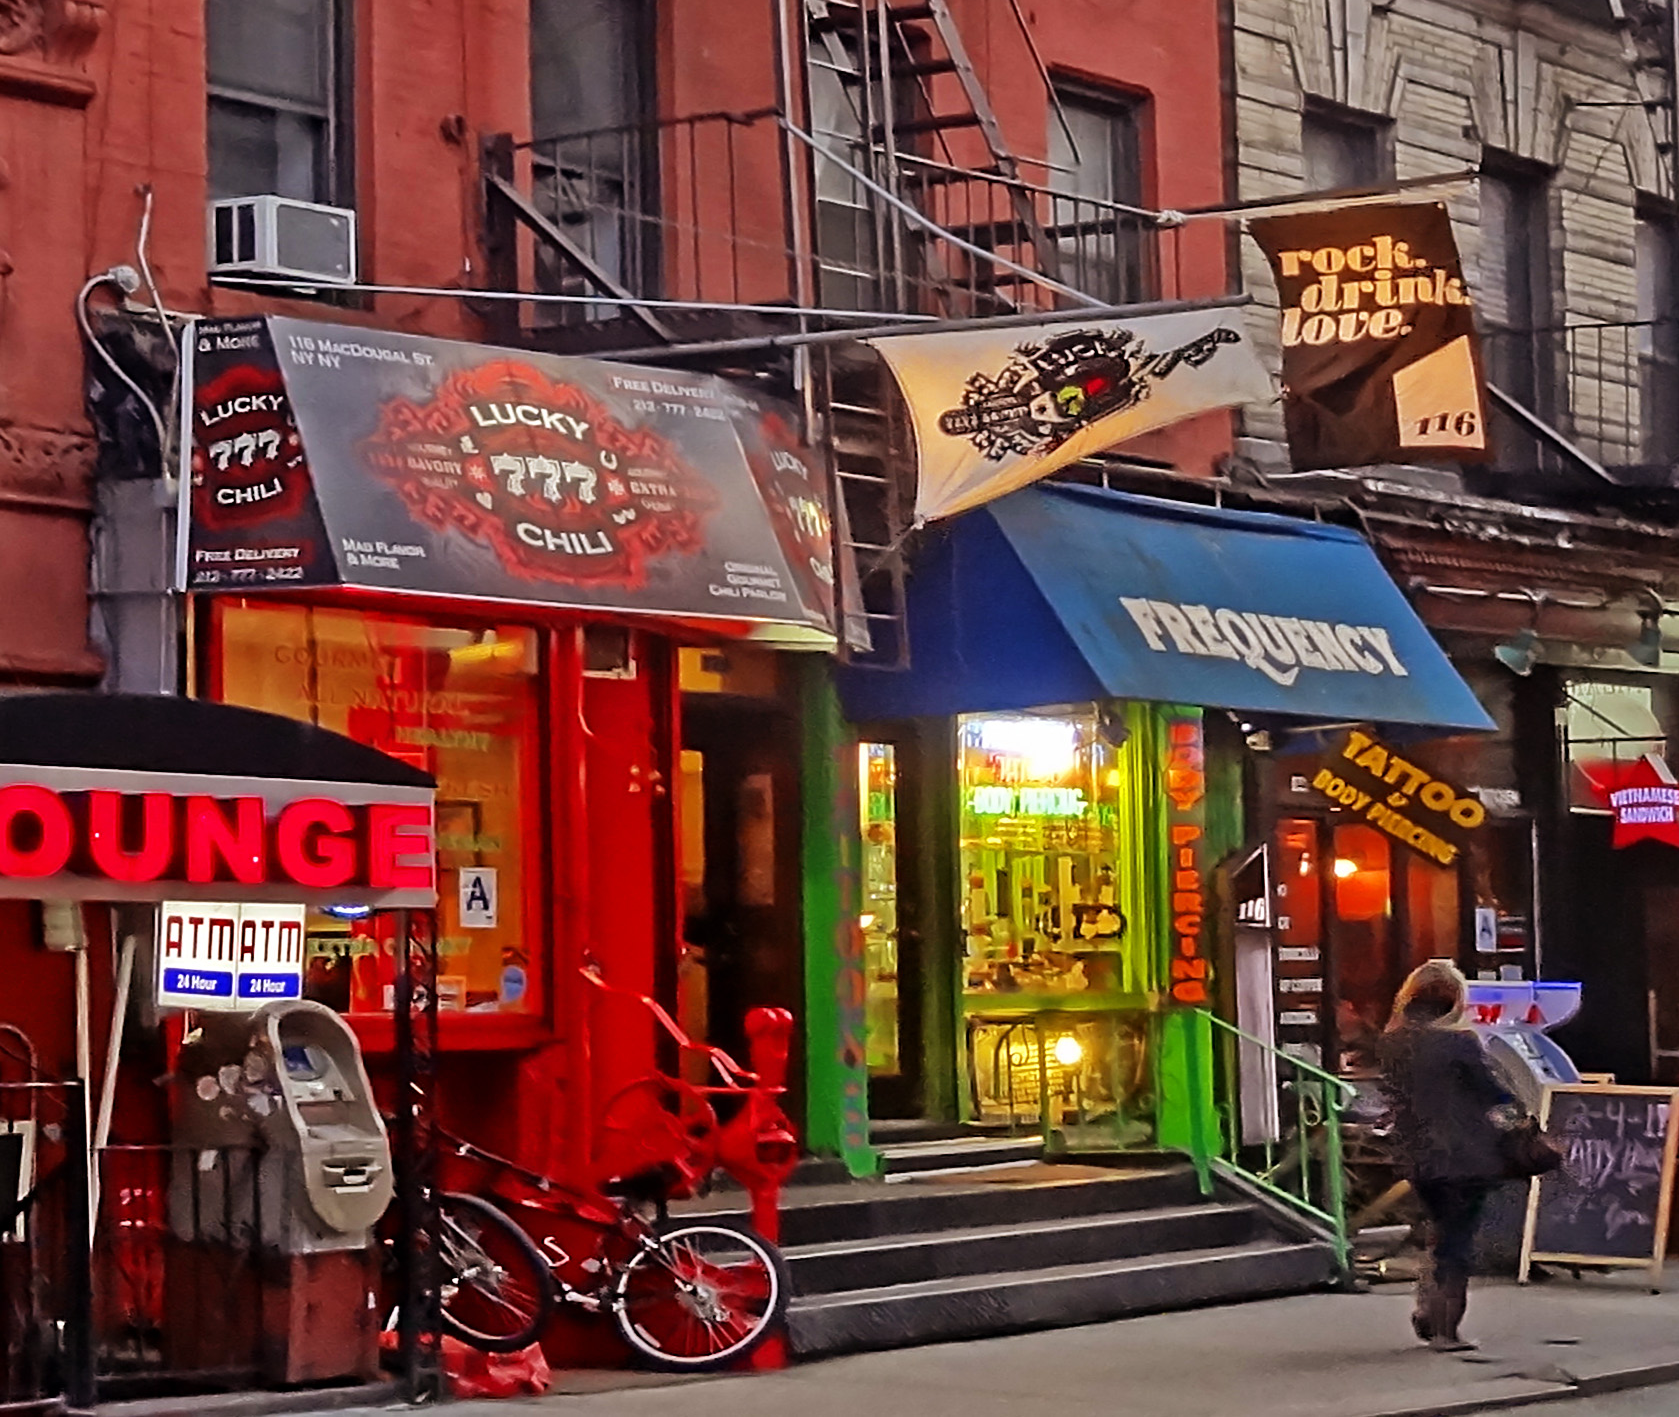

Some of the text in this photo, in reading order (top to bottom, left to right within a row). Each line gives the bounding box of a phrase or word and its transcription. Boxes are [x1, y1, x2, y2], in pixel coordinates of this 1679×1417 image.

[1278, 235, 1427, 276] rock.
[1300, 269, 1472, 313] drink.
[1281, 307, 1413, 346] love.
[291, 351, 341, 369] NY NY
[199, 394, 284, 427] LUCKY
[470, 403, 589, 440] LUCKY
[1416, 410, 1475, 436] 116
[208, 429, 282, 471] 777
[216, 478, 284, 504] CHILI
[490, 453, 597, 504] 777
[516, 522, 614, 555] CHILI
[1119, 597, 1409, 686] FREQUENCY
[1313, 768, 1372, 812] BODY
[1342, 731, 1486, 828] TATTOO
[466, 876, 490, 912] A
[1238, 897, 1266, 921] 116
[165, 915, 235, 962] ATM
[240, 920, 302, 963] ATM
[177, 974, 218, 991] 24 Hour
[249, 978, 286, 993] 24 Hour
